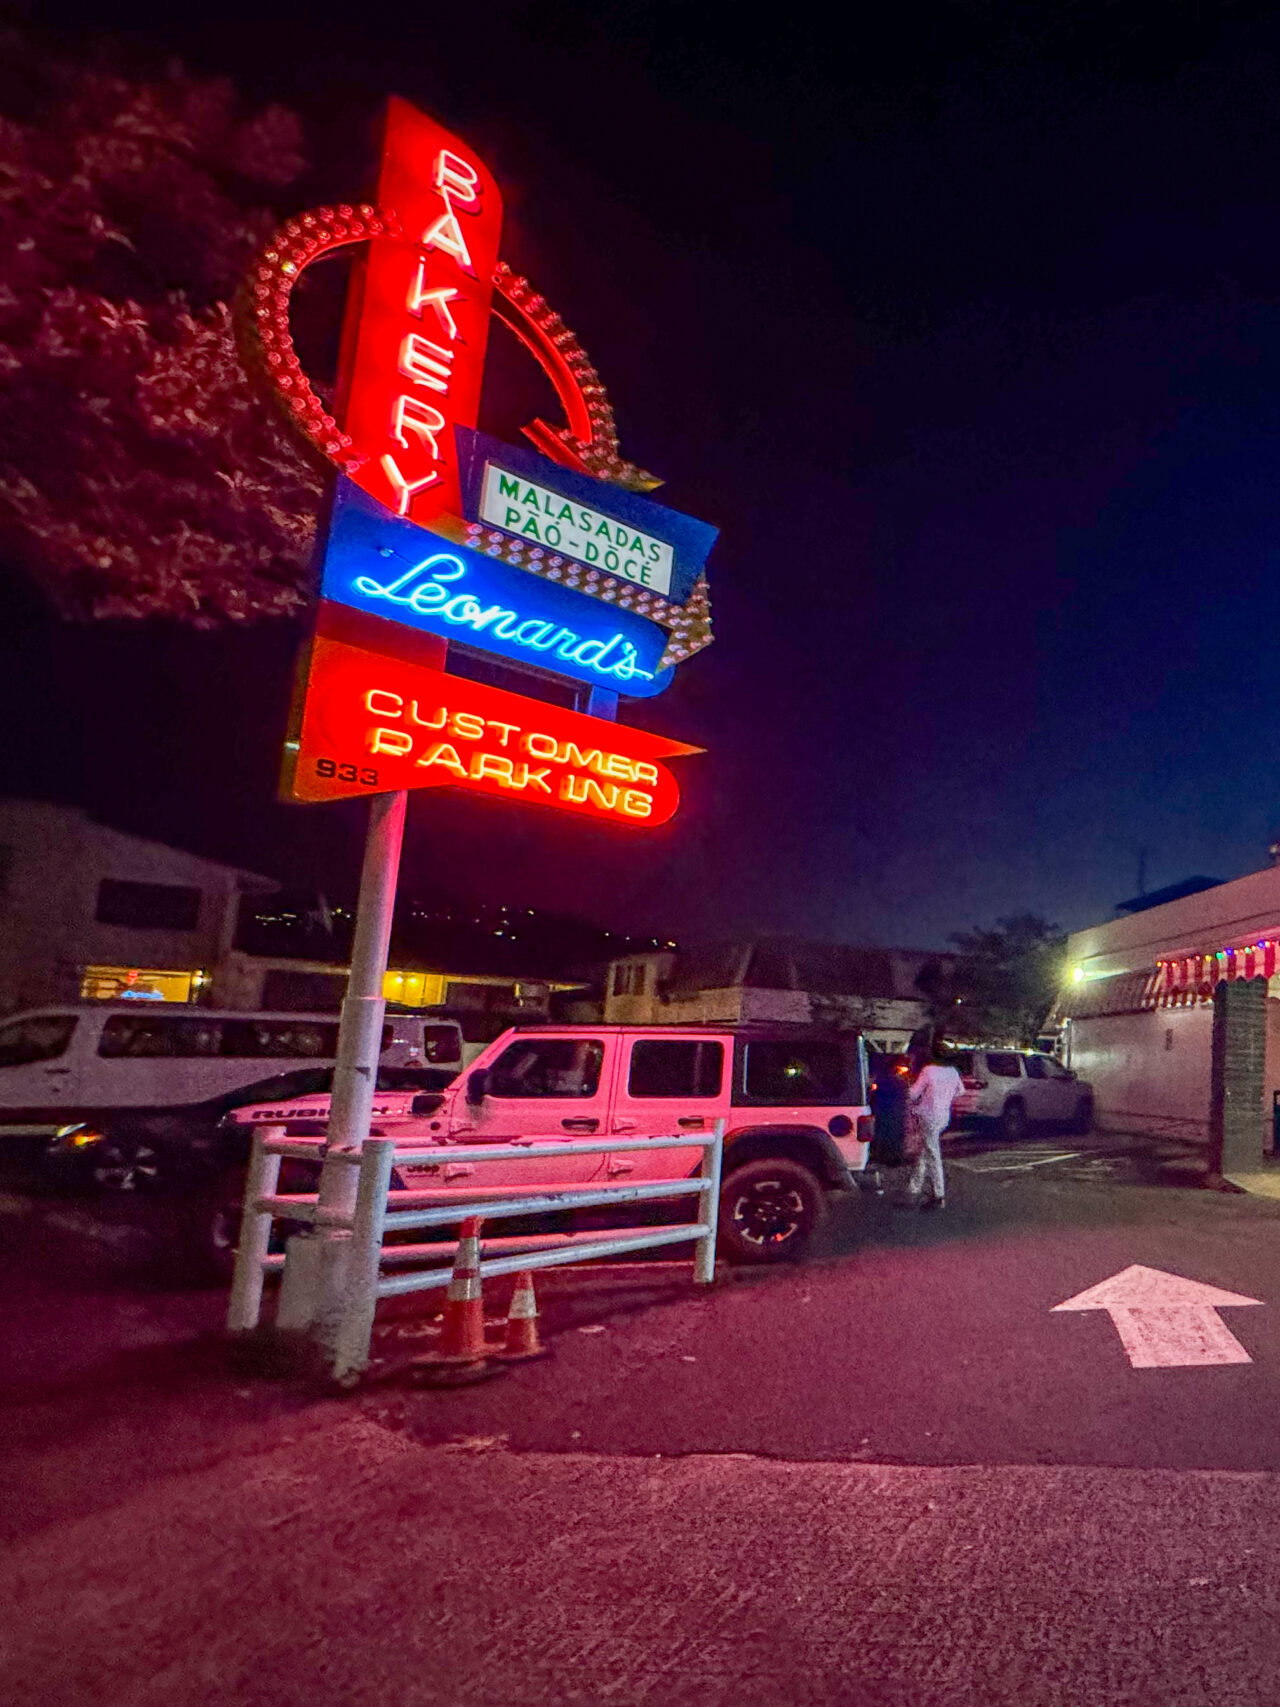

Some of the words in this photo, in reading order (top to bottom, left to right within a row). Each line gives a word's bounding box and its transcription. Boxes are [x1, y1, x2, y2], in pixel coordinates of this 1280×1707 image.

[380, 149, 481, 515] BAKERY
[498, 473, 661, 562] MALASADAS
[353, 552, 655, 680] Leonard's
[315, 758, 379, 786] 933
[365, 688, 659, 787] CUSTOMER
[368, 727, 654, 818] PARKING
